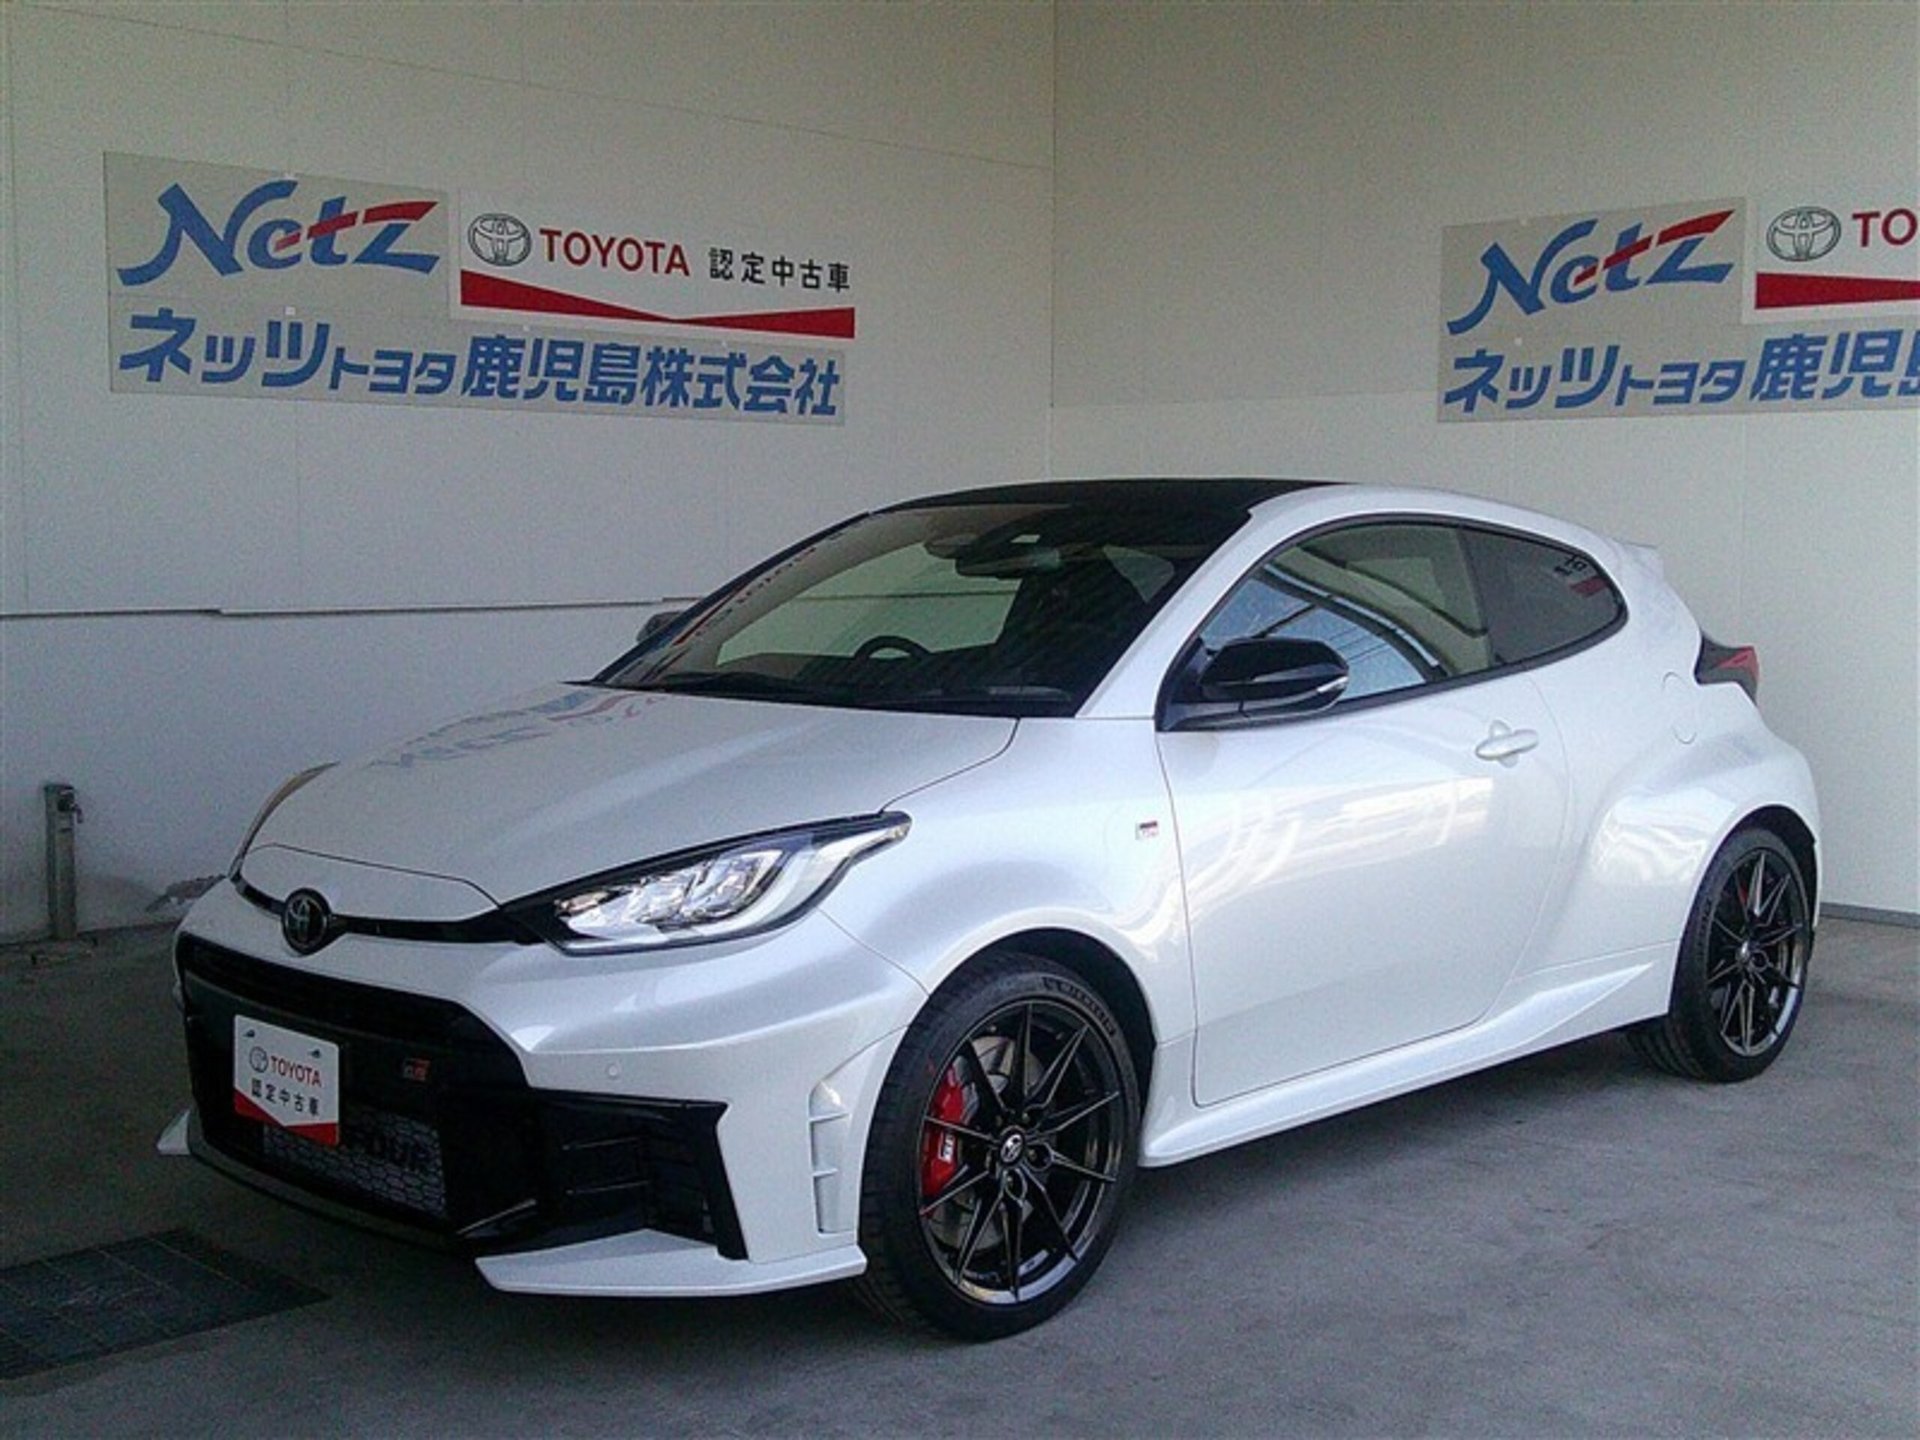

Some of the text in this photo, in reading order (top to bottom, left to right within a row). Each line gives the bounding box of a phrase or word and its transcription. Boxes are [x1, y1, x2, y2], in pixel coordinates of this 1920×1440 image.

[116, 180, 440, 286] Netz
[538, 228, 851, 292] TOYOTA 認定中古車
[1446, 209, 1736, 335] Netz
[118, 306, 840, 417] ネッツトヨタ鹿児島株式会社
[251, 1077, 319, 1116] 認定中古車
[270, 1055, 322, 1088] TOYOTA
